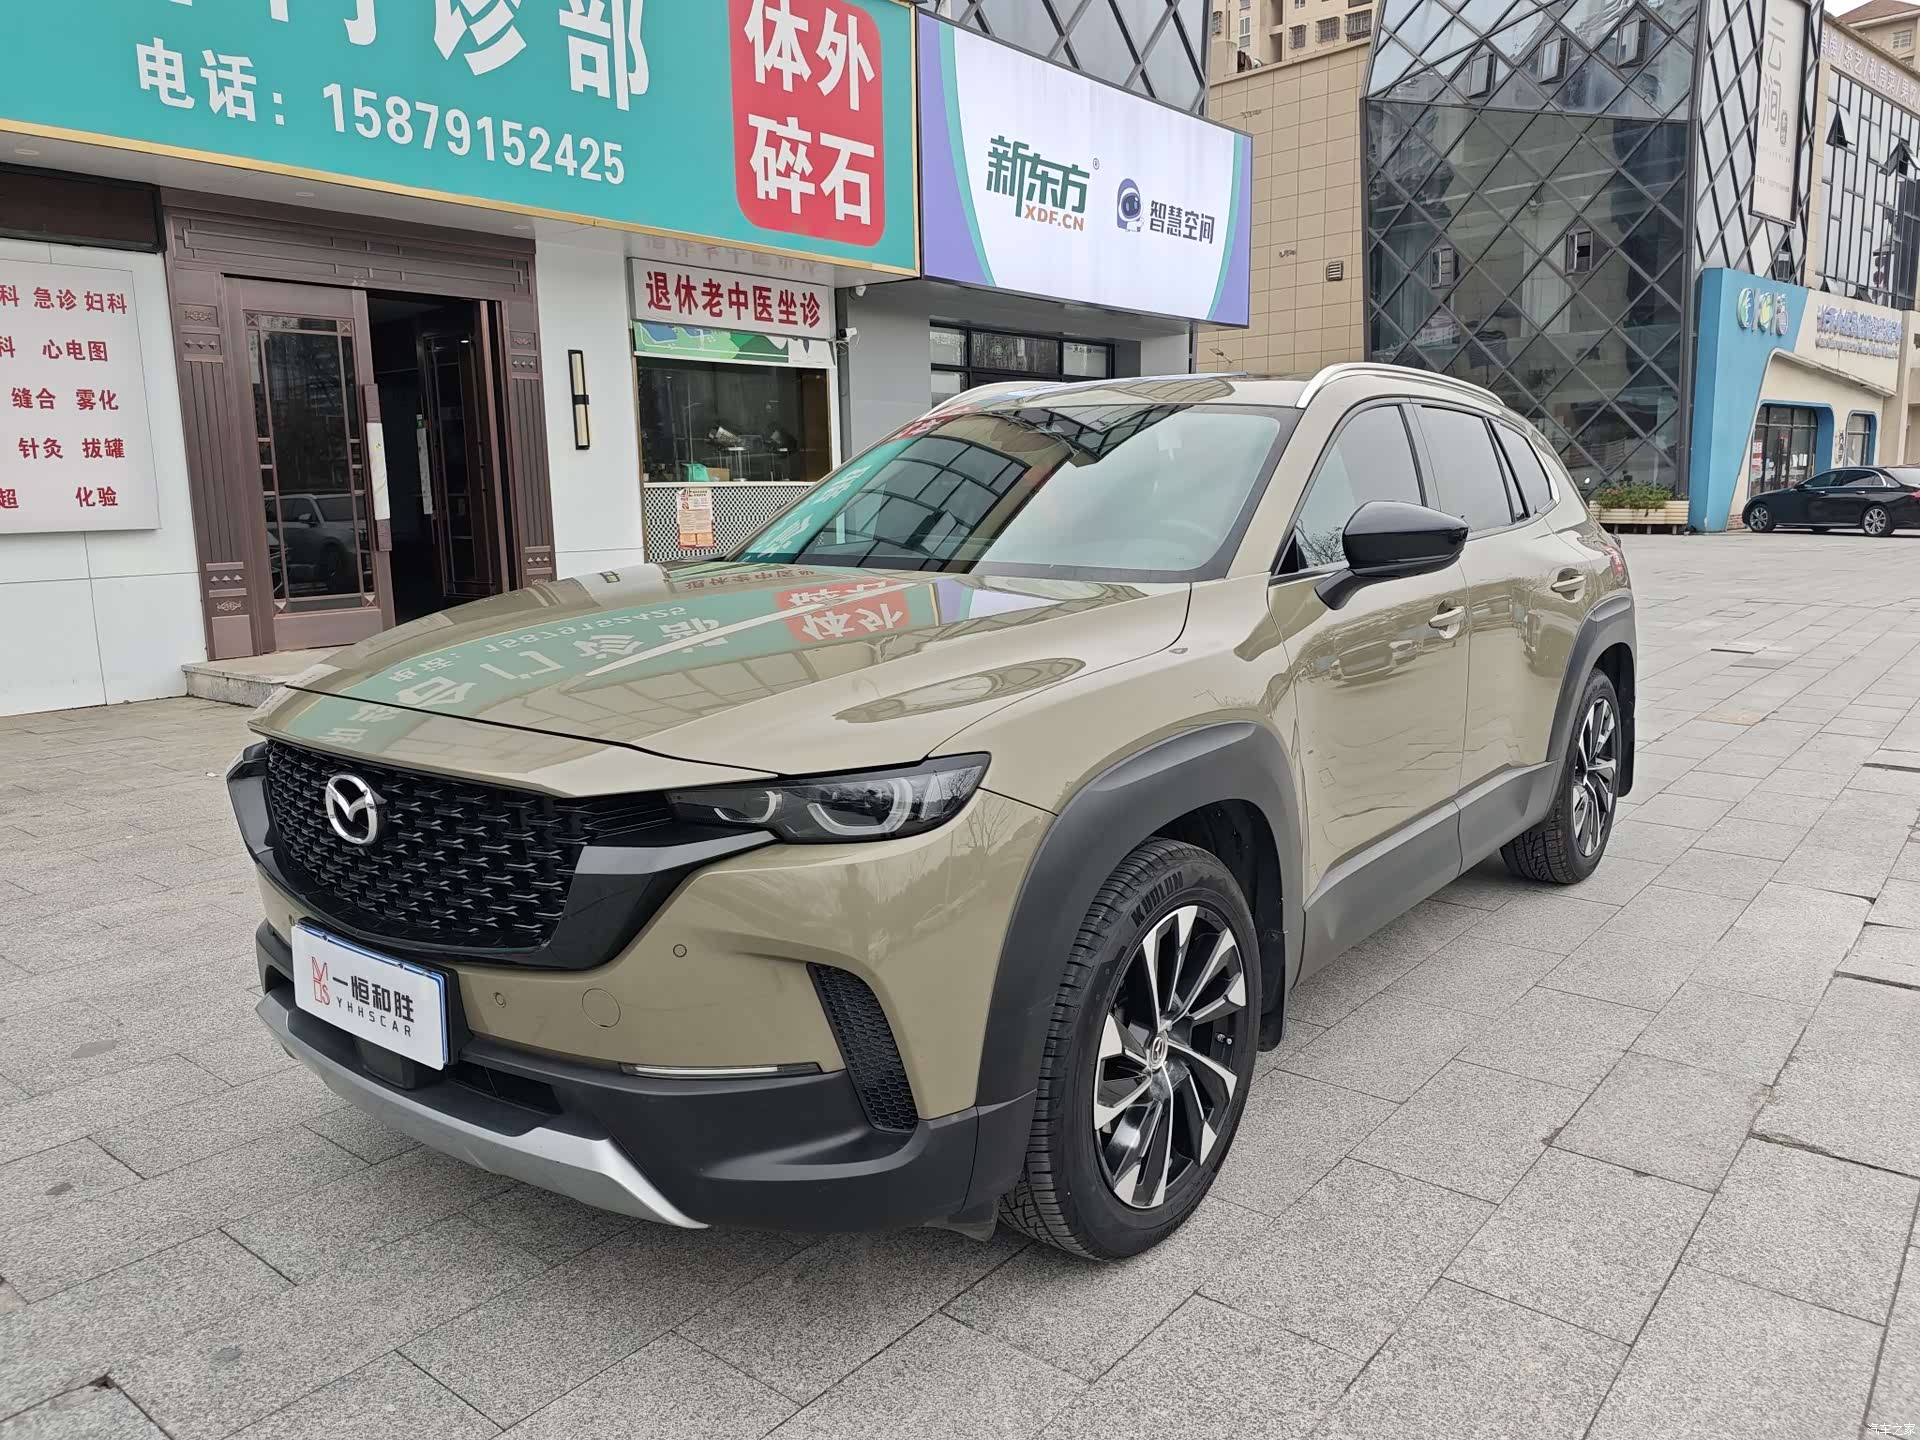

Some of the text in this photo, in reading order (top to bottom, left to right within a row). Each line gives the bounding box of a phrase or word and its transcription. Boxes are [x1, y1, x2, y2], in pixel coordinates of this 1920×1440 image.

[744, 0, 875, 111] 体外
[323, 83, 624, 185] 15879152425
[748, 113, 875, 225] 碎石
[986, 135, 1090, 217] 新东方
[1024, 205, 1084, 231] XDF.CN
[1150, 200, 1215, 244] 智慧空间
[33, 287, 77, 310] 急诊
[84, 291, 127, 314] 妇科
[645, 271, 821, 328] 退休老中医坐诊
[42, 340, 108, 362] 心电图
[11, 388, 119, 410] 缝合 雾化
[18, 438, 125, 459] 针灸 拔罐
[75, 486, 118, 508] 化验
[332, 975, 415, 1023] 一恒和胜
[336, 996, 412, 1038] YHHSCAR
